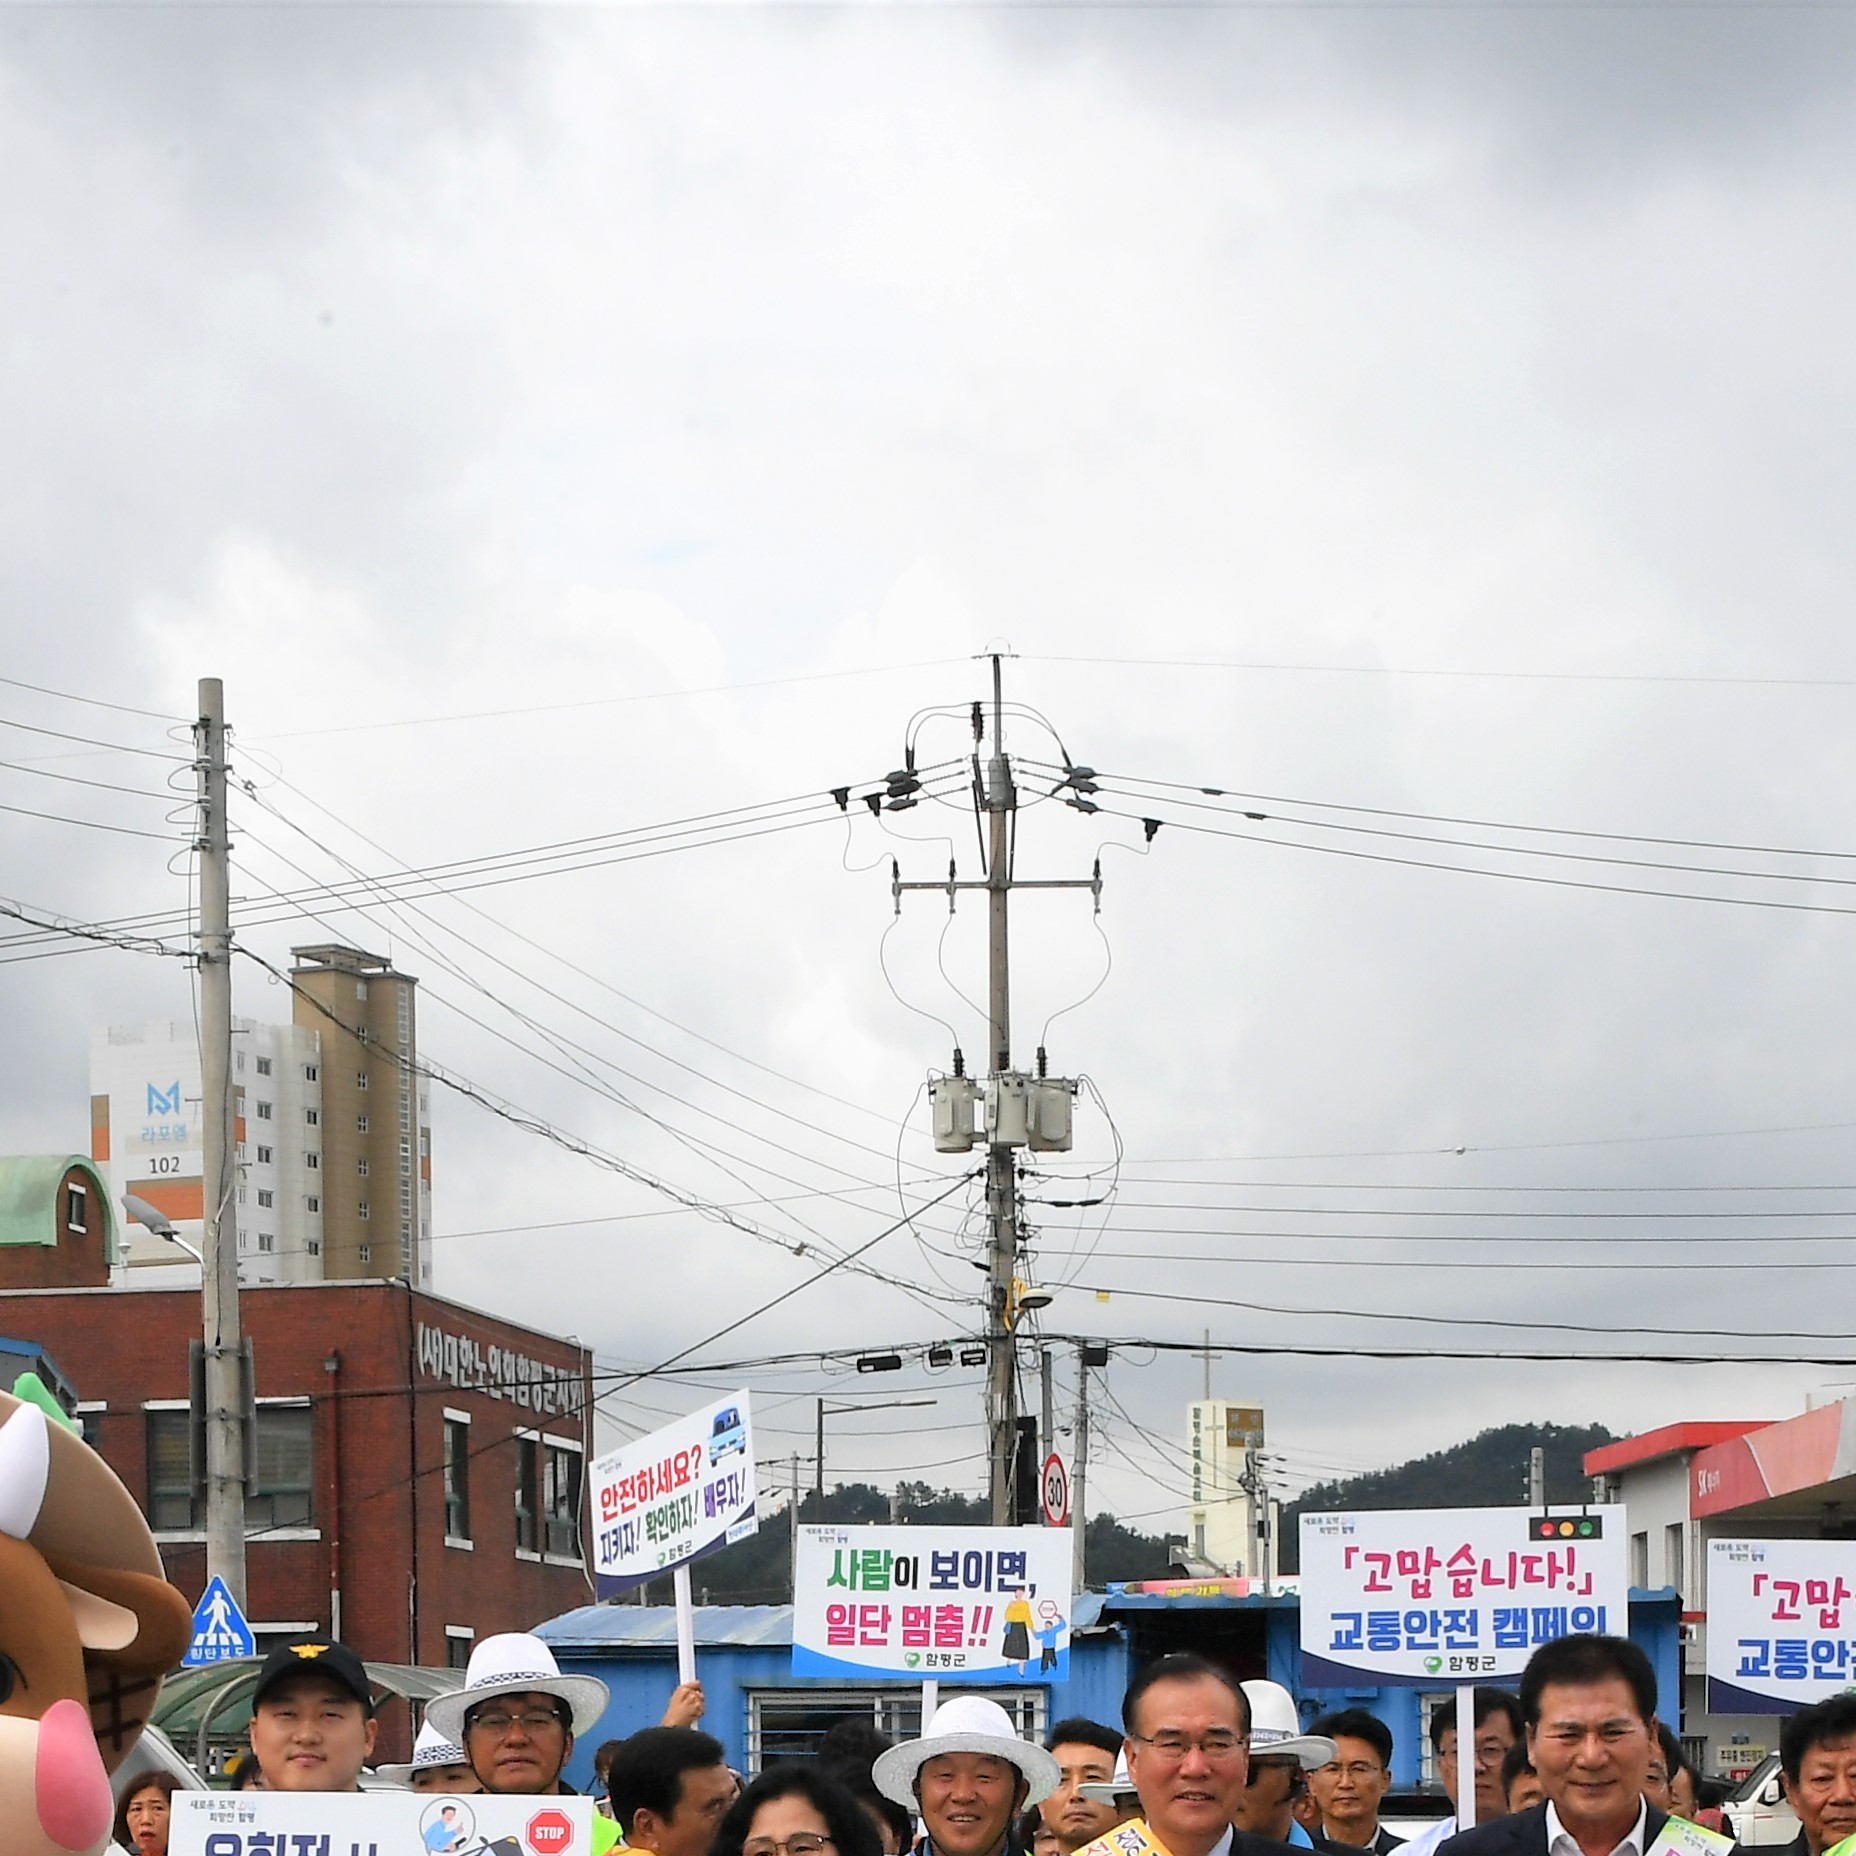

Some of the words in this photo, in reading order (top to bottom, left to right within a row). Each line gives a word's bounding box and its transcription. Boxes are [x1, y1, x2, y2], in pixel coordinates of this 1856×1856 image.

[149, 1156, 179, 1174] 102
[600, 1444, 702, 1523] 안전하세요?
[1047, 1476, 1062, 1508] 30
[600, 1516, 641, 1566] 지키자!
[645, 1489, 699, 1545] 확인하자!
[704, 1467, 746, 1519] 배우자!
[827, 1549, 919, 1591] 사람이
[929, 1550, 1037, 1599] 보이면,
[826, 1603, 892, 1646] 일단
[901, 1603, 993, 1648] 멈춤!!
[1329, 1607, 1479, 1652] 교통안전
[190, 1646, 246, 1661] 횡단보도
[925, 1652, 967, 1668] 함평군
[1449, 1656, 1496, 1672] 함평군
[534, 1825, 565, 1840] STOP
